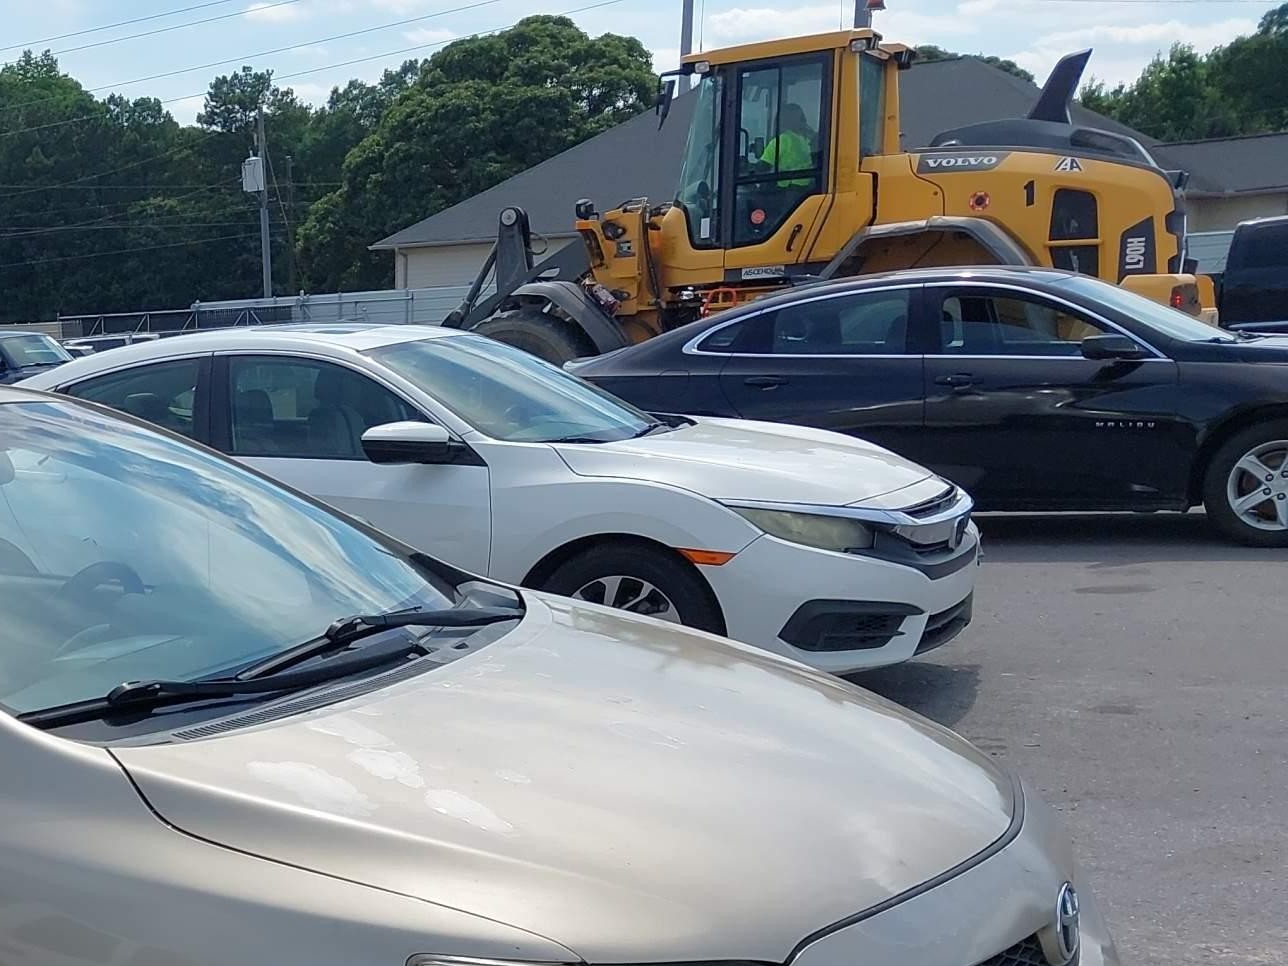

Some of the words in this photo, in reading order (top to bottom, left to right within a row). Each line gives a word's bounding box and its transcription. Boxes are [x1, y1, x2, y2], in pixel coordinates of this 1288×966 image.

[926, 156, 998, 168] VOLVO
[1023, 180, 1035, 207] 1
[1125, 236, 1146, 269] L90H
